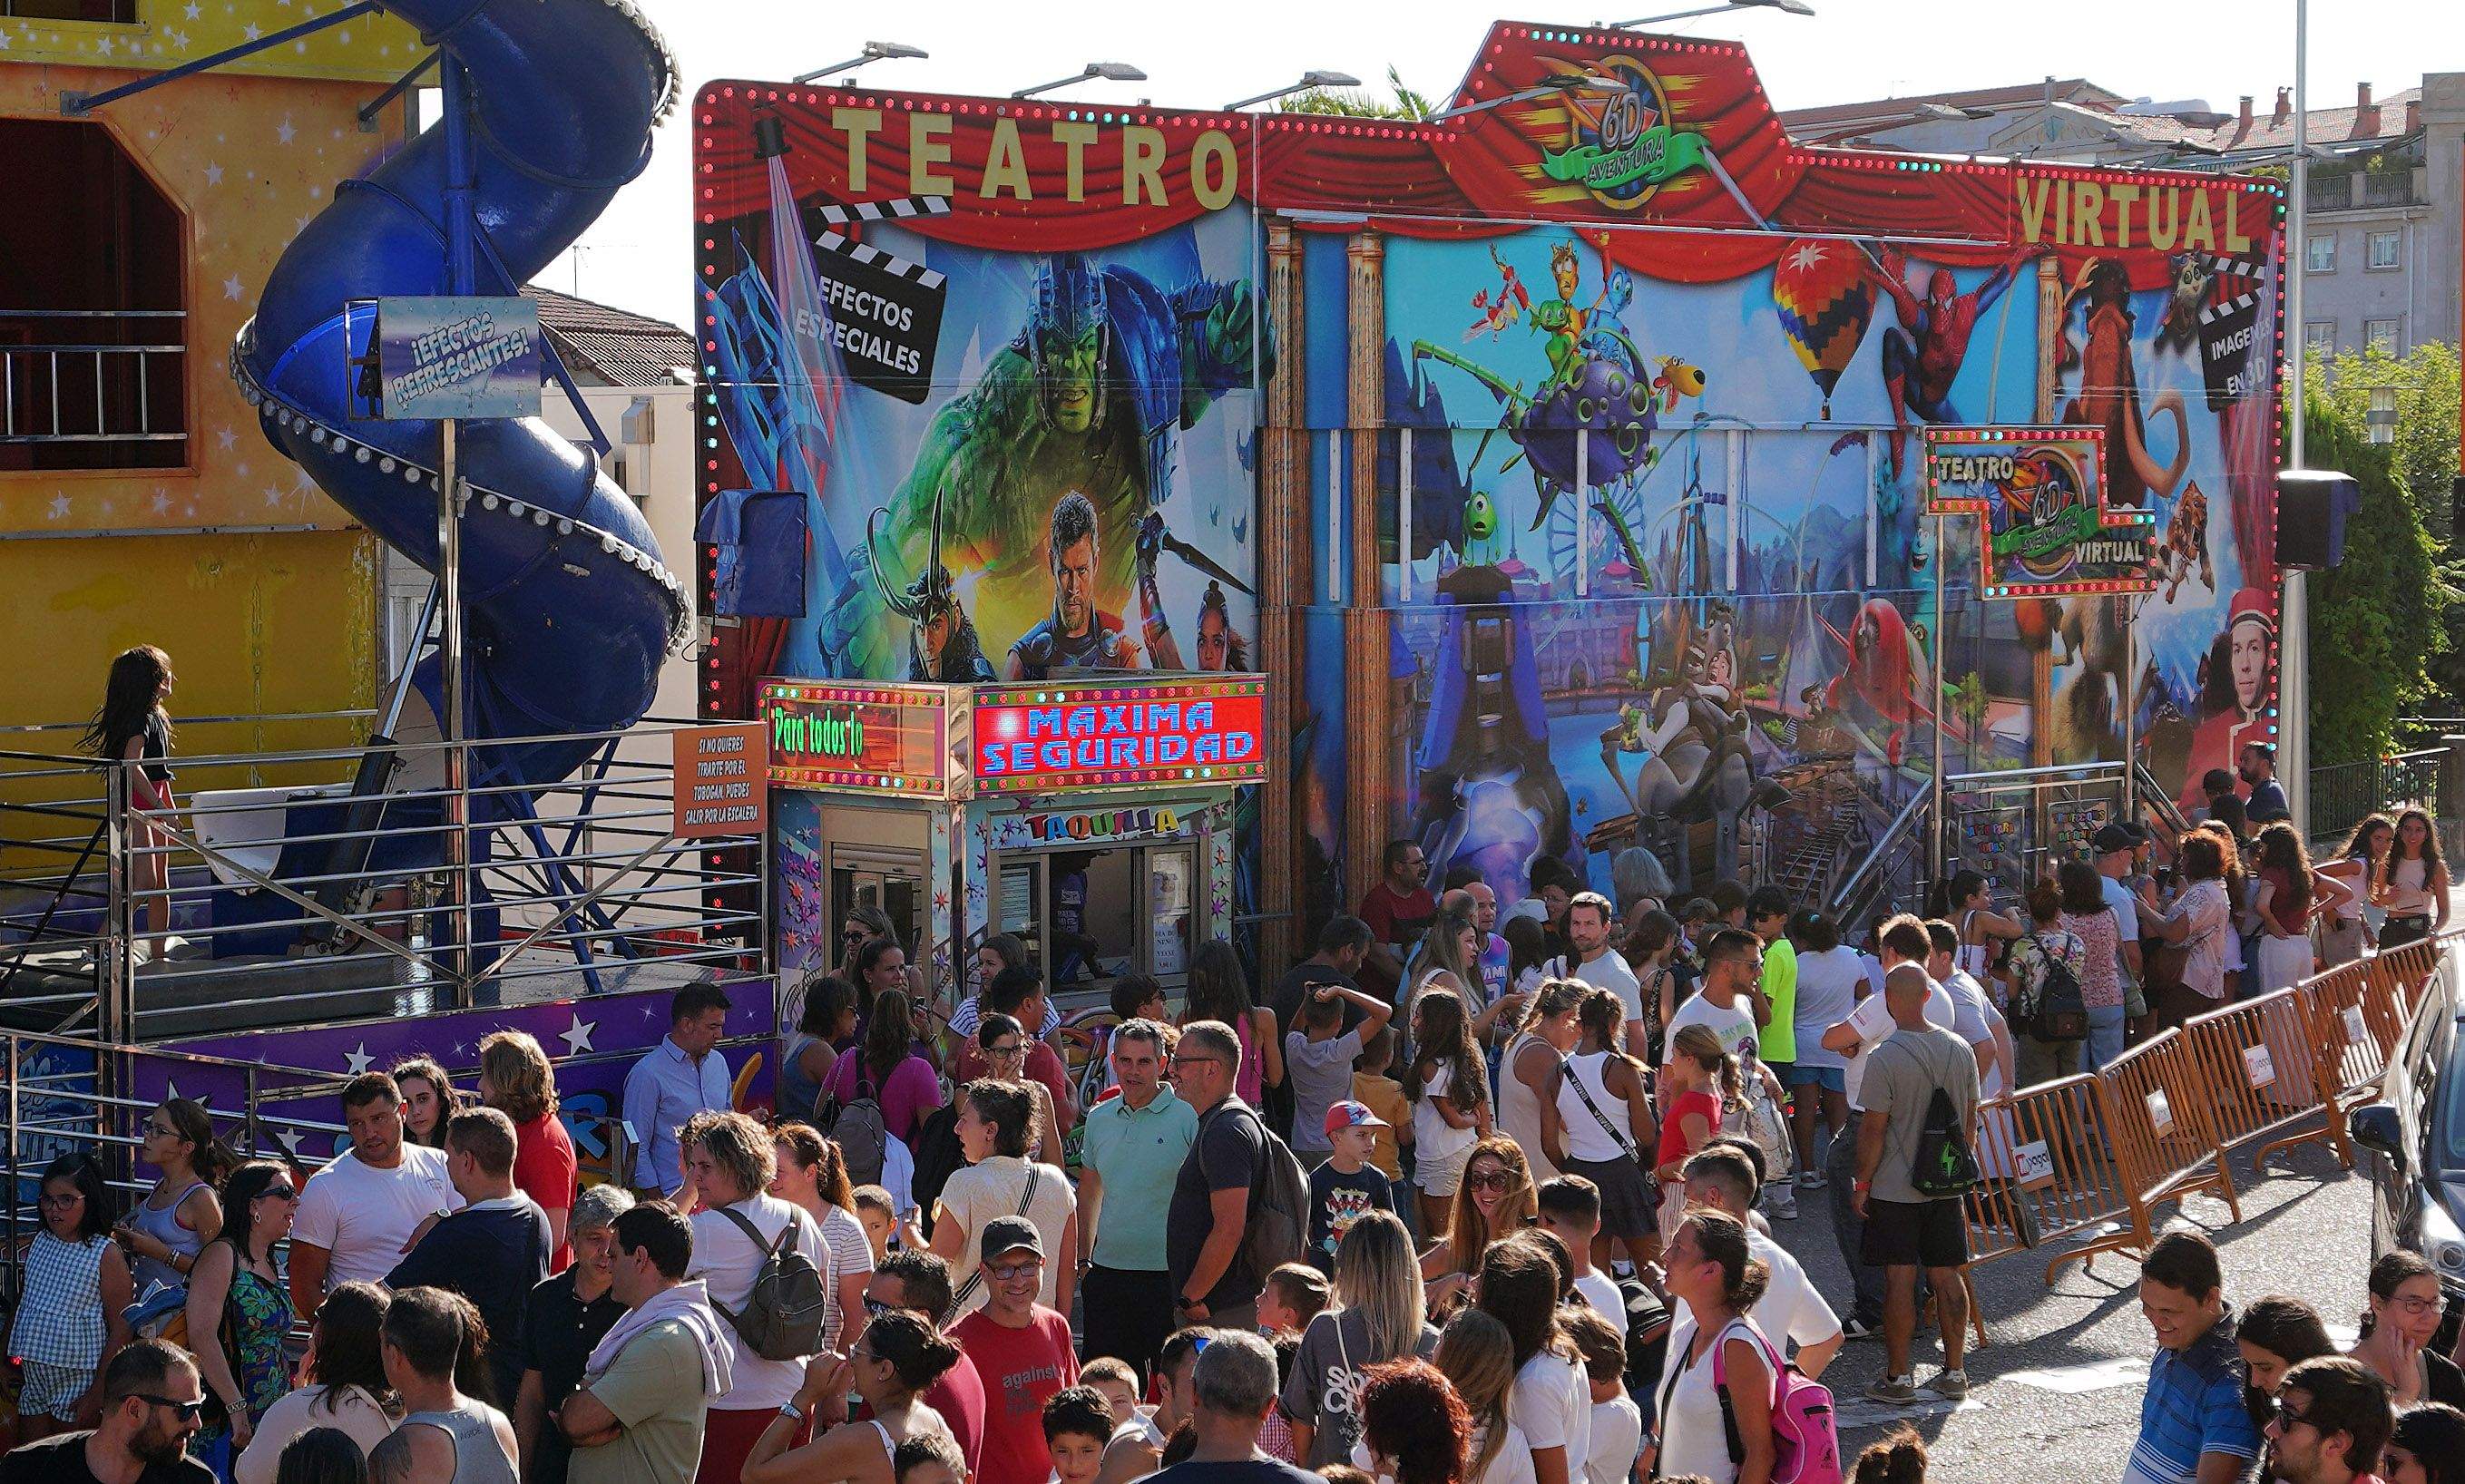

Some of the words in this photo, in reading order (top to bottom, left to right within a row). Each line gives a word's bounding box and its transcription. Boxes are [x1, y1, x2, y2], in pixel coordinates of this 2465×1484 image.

[1602, 92, 1644, 148] 6D
[832, 107, 1238, 211] TEATRO
[1589, 134, 1666, 181] AVENTURA
[2017, 177, 2251, 253] VIRTUAL
[817, 275, 914, 332] EFECTOS
[411, 311, 495, 367] ¡EFECTOS
[795, 308, 921, 375] ESPECIALES
[391, 327, 531, 405] REFRESCANTES!
[2226, 372, 2245, 396] EN
[1939, 455, 2015, 482] TEATRO
[2074, 541, 2145, 565] VIRTUAL
[775, 707, 806, 753] Para
[808, 708, 846, 756] todos
[1028, 701, 1214, 737] MAXIMA
[699, 737, 706, 754] SI
[706, 737, 716, 753] NO
[716, 736, 744, 754] QUIERES
[982, 731, 1254, 772] SEGURIDAD
[697, 761, 723, 777] TIRARTE
[724, 759, 738, 776] POR
[738, 759, 746, 775] EL
[725, 782, 750, 798] PUEDES
[685, 808, 703, 825] SALIR
[704, 807, 718, 823] POR
[727, 805, 758, 821] ESCALERA
[1023, 808, 1181, 841] TAQUILLA
